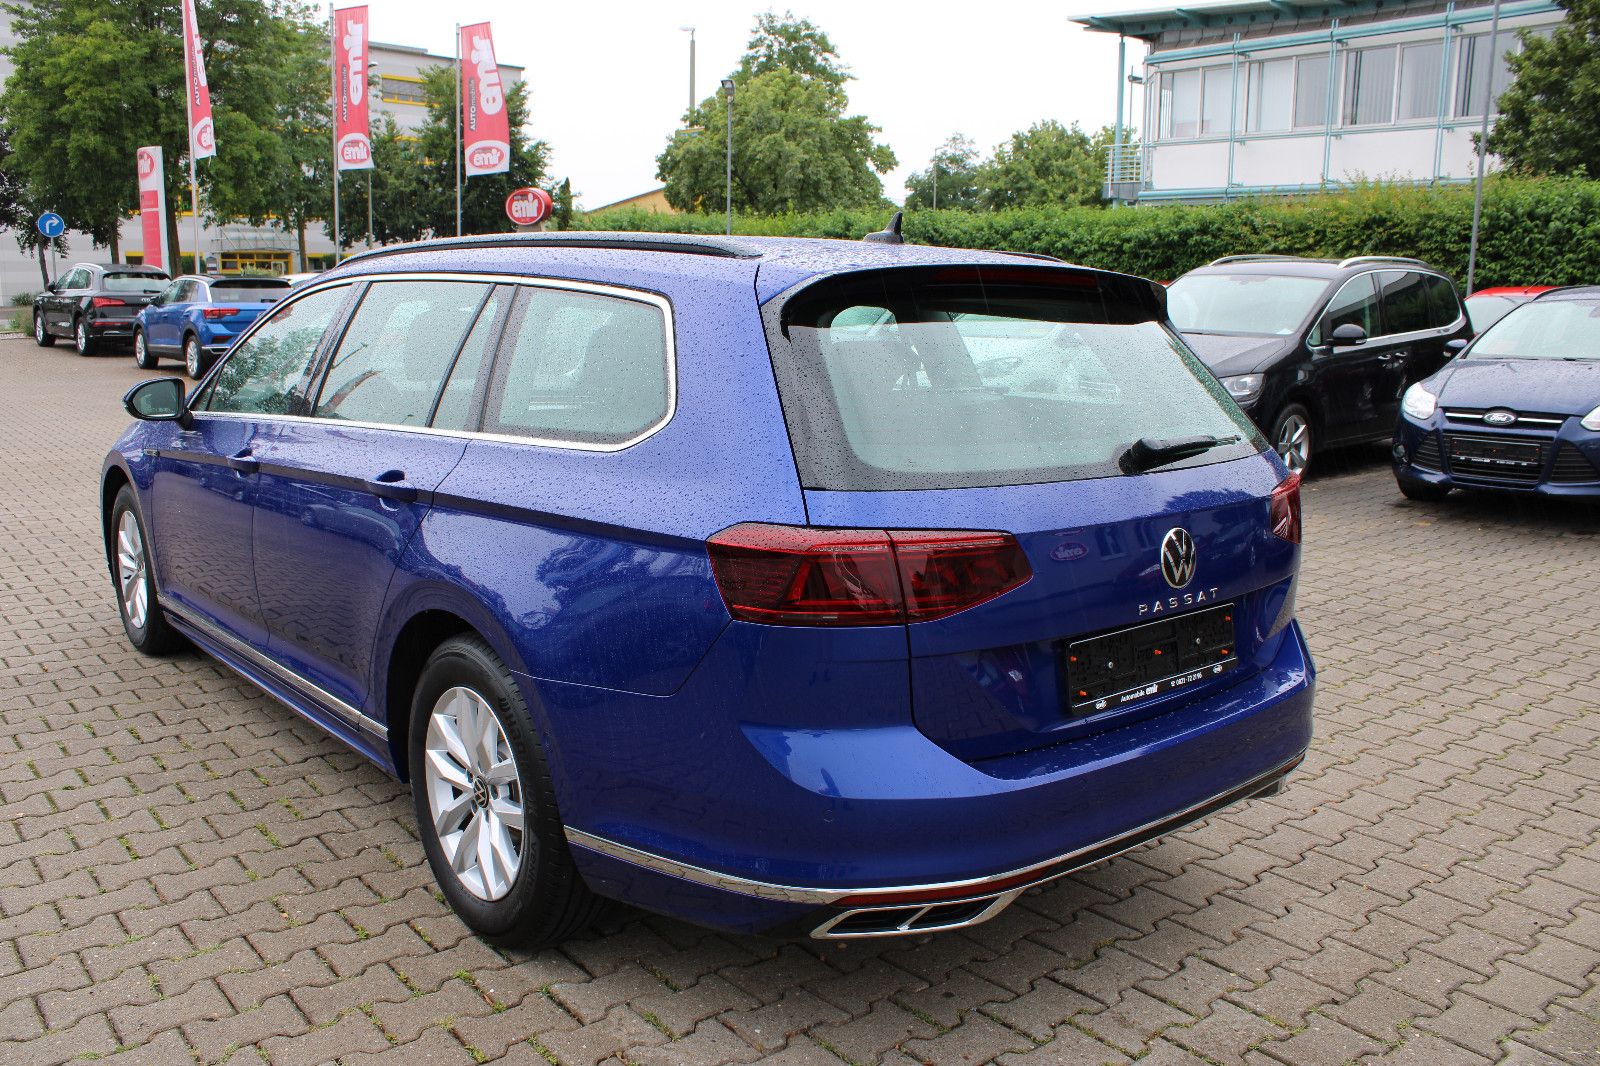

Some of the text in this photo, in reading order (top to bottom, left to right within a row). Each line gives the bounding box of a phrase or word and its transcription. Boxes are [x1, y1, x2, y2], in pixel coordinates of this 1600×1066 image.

[343, 20, 363, 106] emir
[471, 35, 503, 115] emir
[344, 142, 368, 160] emir
[474, 149, 500, 167] emir
[512, 193, 538, 218] emir
[1138, 587, 1219, 616] PASSAT
